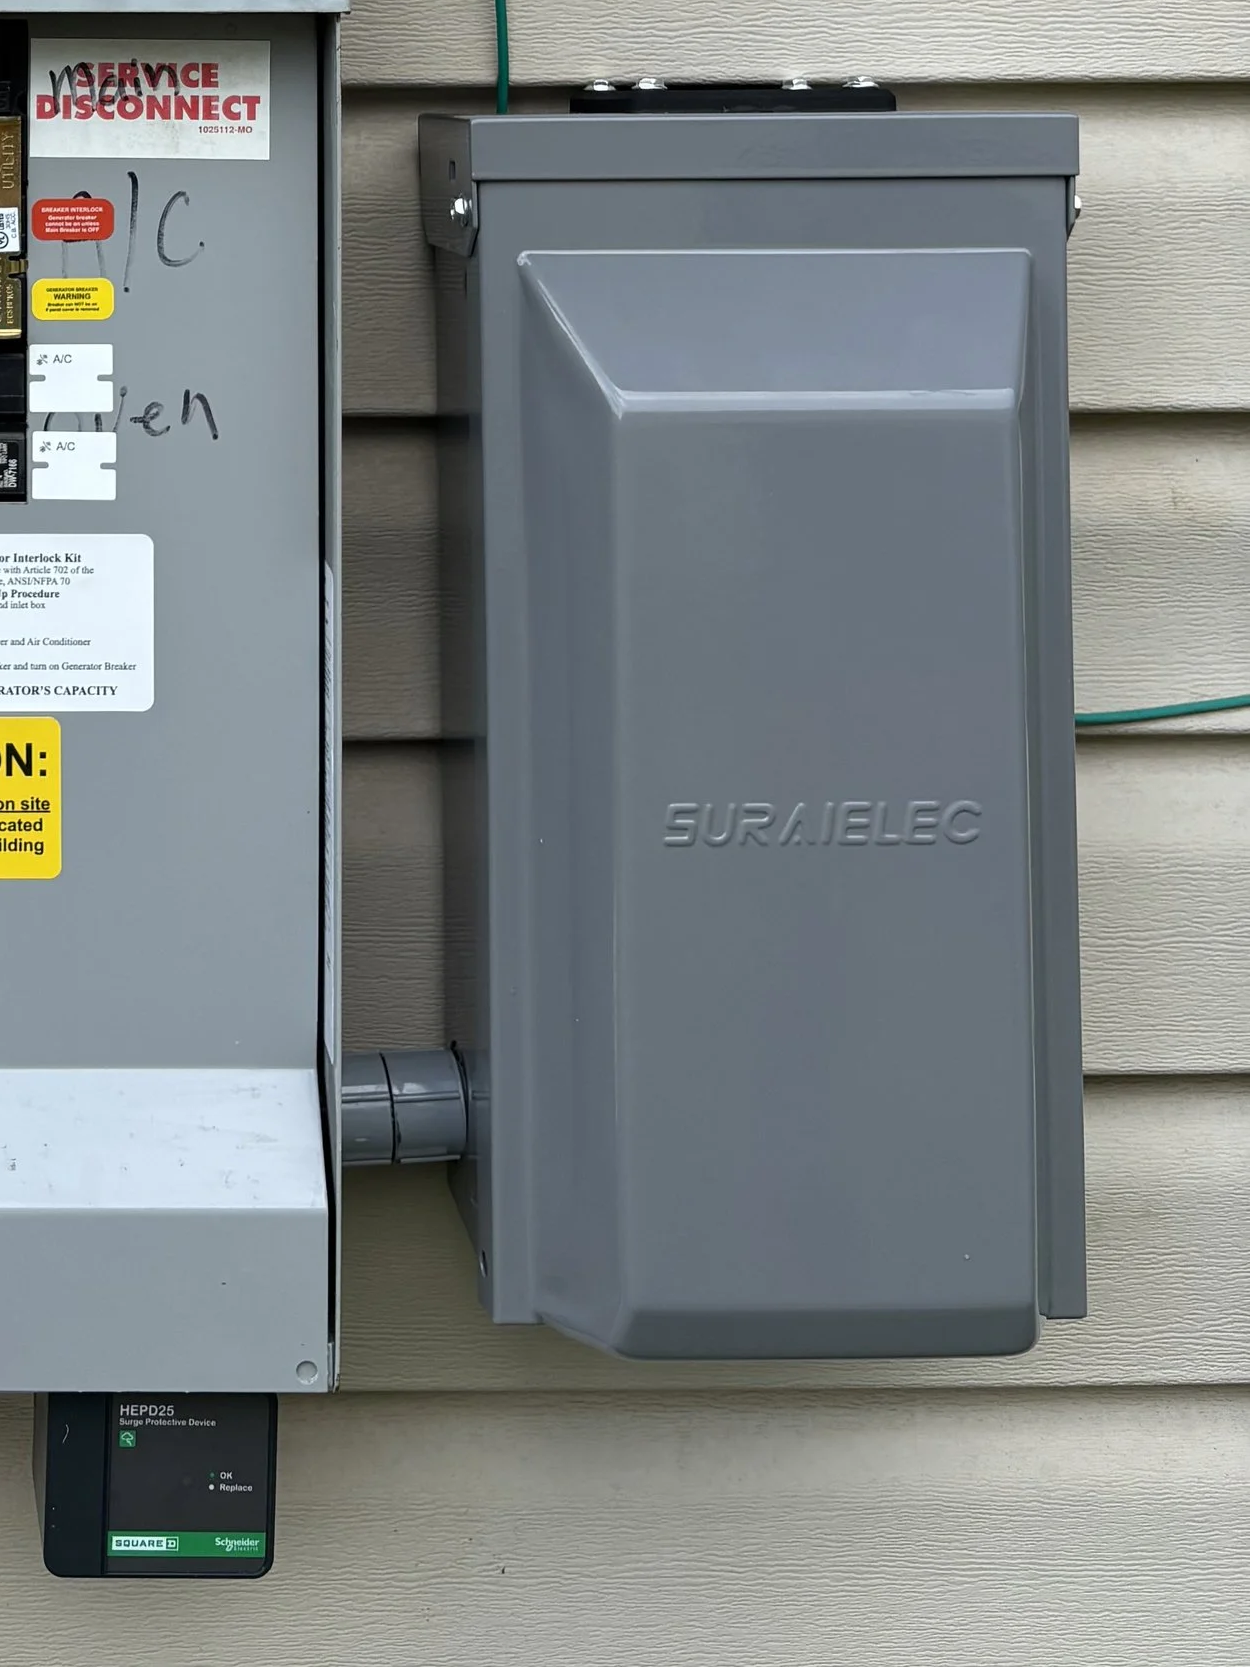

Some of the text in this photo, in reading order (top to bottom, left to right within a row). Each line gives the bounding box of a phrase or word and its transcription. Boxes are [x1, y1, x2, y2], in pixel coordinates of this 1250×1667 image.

[75, 62, 219, 88] SERVICE
[36, 95, 261, 120] DISCONNECT
[1, 131, 14, 190] UTILITY
[53, 354, 72, 364] A/C
[56, 442, 76, 451] A/C
[14, 553, 61, 562] Interlock
[65, 553, 81, 562] Kit
[11, 590, 60, 598] Procedure
[10, 638, 25, 646] and
[43, 638, 91, 646] Conditioner
[54, 686, 118, 695] CAPACITY
[21, 797, 50, 810] site
[120, 1404, 174, 1416] HEPD25
[119, 1418, 216, 1427] Surge Protective Device
[220, 1472, 232, 1480] OK
[219, 1484, 253, 1492] Replace
[115, 1539, 164, 1547] SQUARE
[215, 1537, 259, 1552] Schneider
